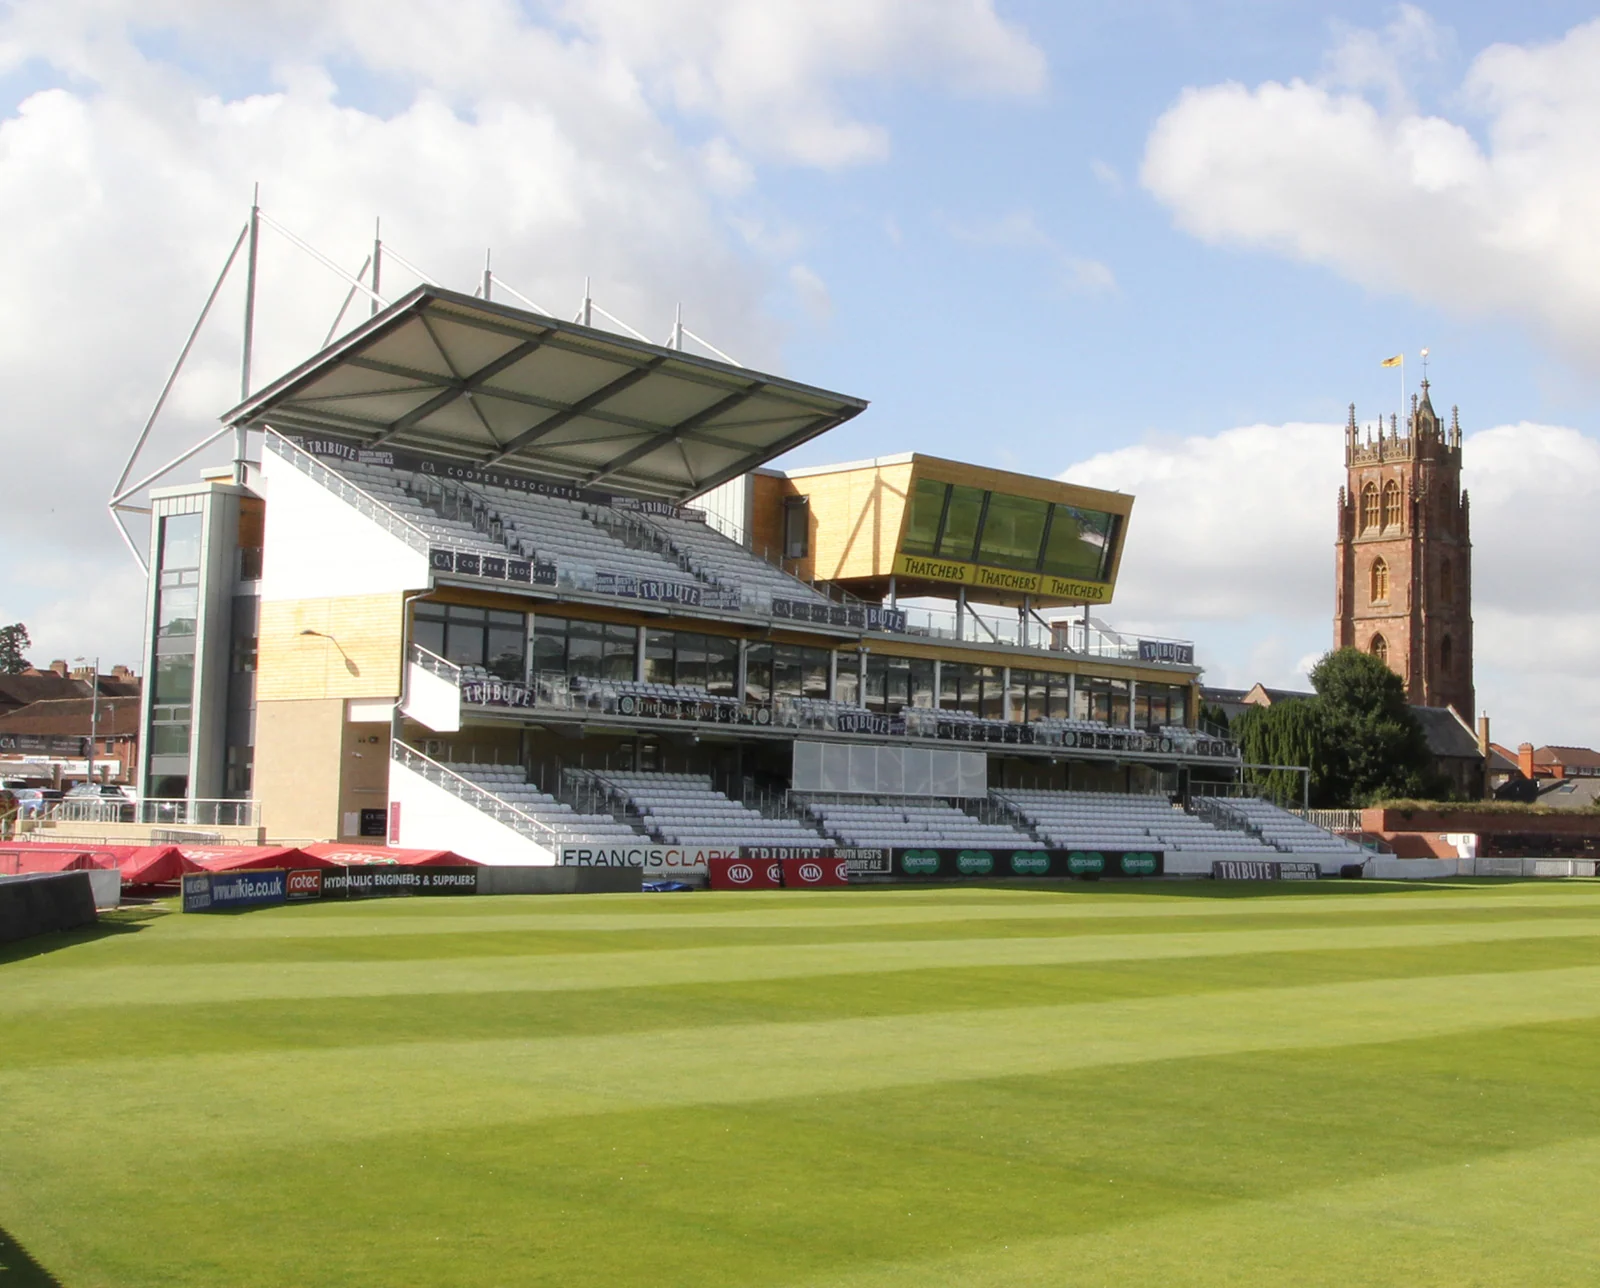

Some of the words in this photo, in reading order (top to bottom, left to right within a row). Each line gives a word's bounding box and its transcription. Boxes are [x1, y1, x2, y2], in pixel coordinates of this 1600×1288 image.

[307, 440, 356, 460] TRIBUTE
[421, 461, 435, 473] CA
[447, 467, 499, 483] COOPER
[504, 478, 581, 499] ASSOCIATES
[641, 502, 678, 518] TRIBUTE
[434, 553, 451, 568] CA
[461, 560, 499, 571] COOPER
[905, 558, 966, 580] THATCHERS
[981, 569, 1037, 590] THATCHERS
[642, 582, 699, 605] TRIBUTE
[1051, 579, 1105, 600] THATCHERS
[1144, 644, 1188, 661] TRIBUTE
[464, 684, 532, 707] TRIBUTE
[840, 715, 888, 733] TRIBUTE
[0, 738, 16, 749] CA
[834, 849, 857, 859] SOUTH
[857, 849, 882, 859] WEST'S
[905, 855, 937, 867] Specsavers
[960, 856, 991, 868] Specsavers
[846, 859, 868, 870] OURITE
[869, 860, 882, 870] ALE
[1014, 857, 1047, 868] Specsavers
[1070, 858, 1102, 869] Specsavers
[1124, 858, 1154, 869] Specsavers
[1220, 861, 1272, 880] TRIBUTE
[290, 874, 319, 889] rotec
[324, 874, 372, 889] HYDRAULIC
[375, 873, 421, 886] ENGINEERS
[423, 875, 430, 886] &
[433, 873, 476, 886] SUPPLIERS
[731, 868, 749, 881] KIA
[802, 867, 819, 880] KIA
